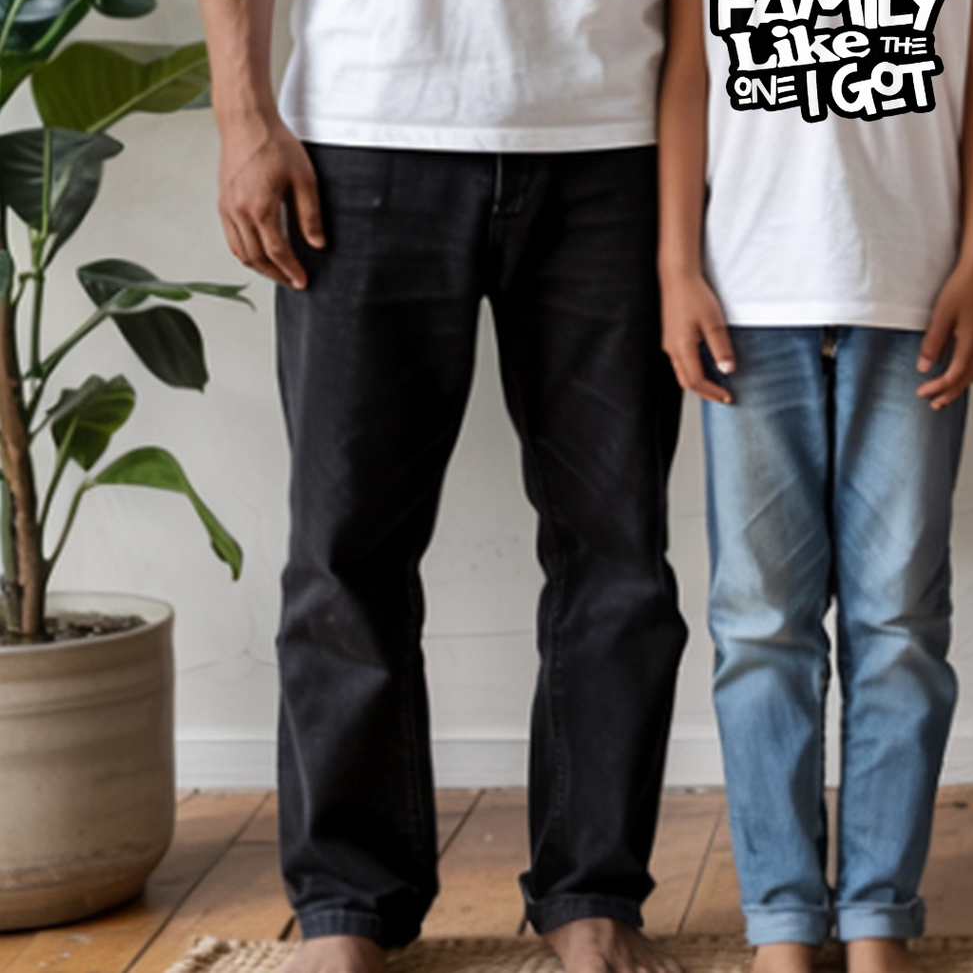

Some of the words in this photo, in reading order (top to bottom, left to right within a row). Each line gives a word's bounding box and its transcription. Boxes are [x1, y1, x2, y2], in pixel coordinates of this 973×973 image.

[729, 24, 873, 72] Like
[879, 35, 929, 56] THE
[733, 74, 800, 106] ONE
[831, 59, 938, 116] GOT
